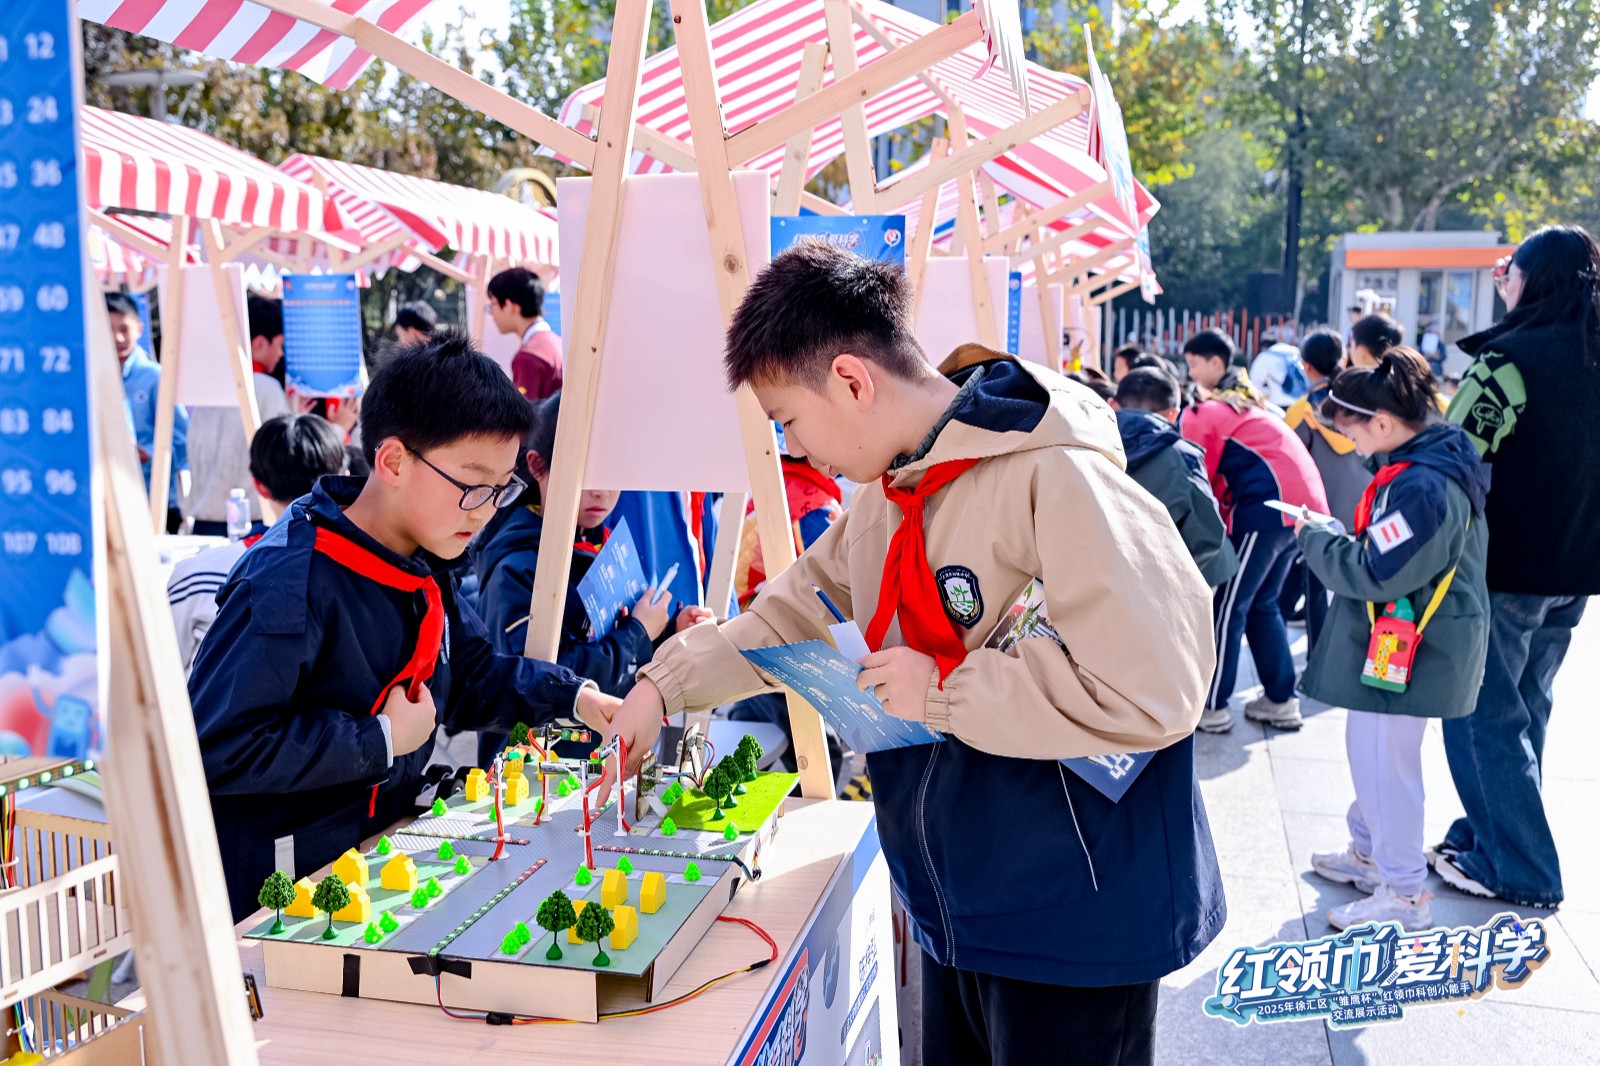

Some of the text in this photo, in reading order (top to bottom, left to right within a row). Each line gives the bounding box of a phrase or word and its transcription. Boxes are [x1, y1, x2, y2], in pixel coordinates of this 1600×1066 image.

[24, 31, 55, 59] 12
[27, 95, 58, 124] 24
[31, 159, 62, 187] 36
[33, 222, 66, 249] 48
[36, 285, 69, 312] 60
[0, 346, 71, 373] 71 72
[0, 408, 74, 434] 83 84
[1, 468, 77, 495] 95 96
[45, 531, 82, 555] 108
